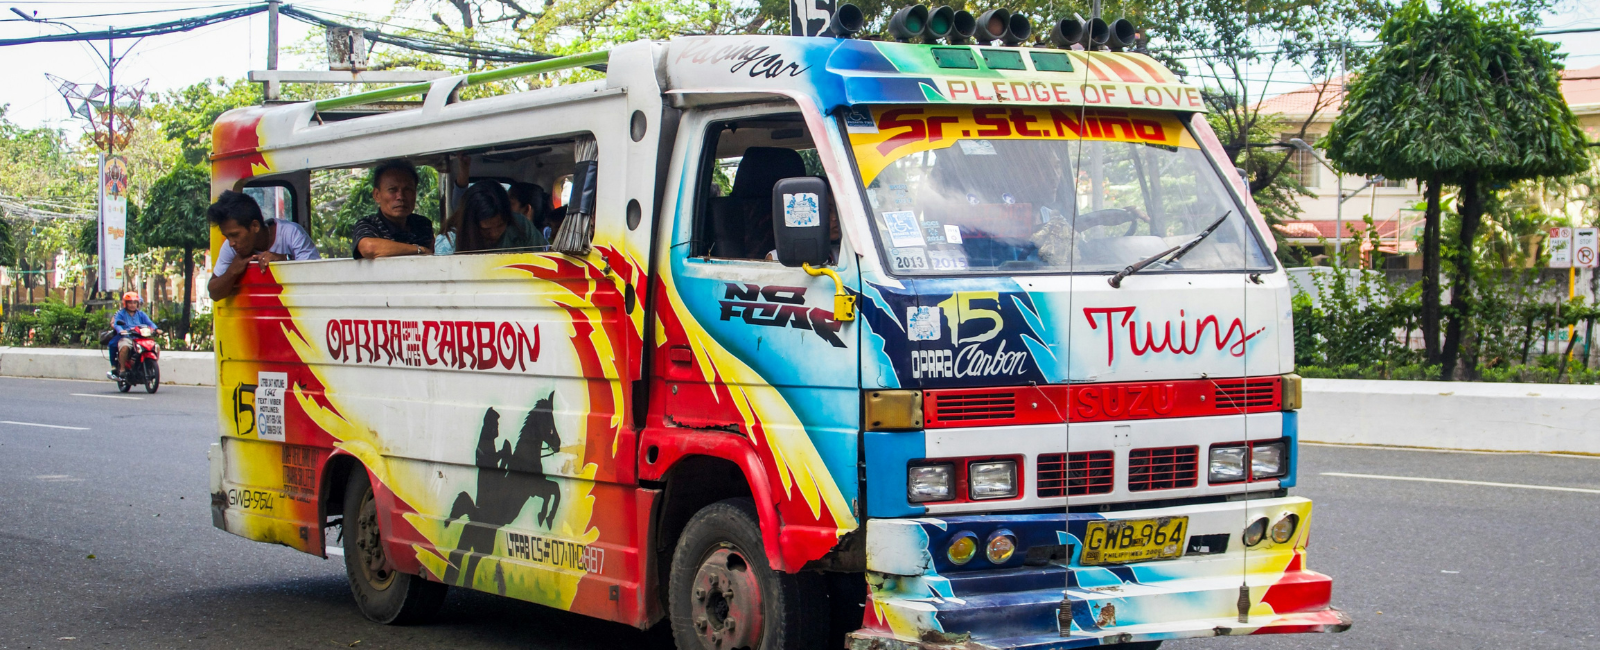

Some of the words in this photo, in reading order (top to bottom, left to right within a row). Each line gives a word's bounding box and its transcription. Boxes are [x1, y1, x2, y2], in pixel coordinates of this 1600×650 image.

[791, 0, 832, 37] 15
[675, 37, 769, 73] Racing
[749, 53, 813, 78] Car
[947, 80, 1070, 103] PLEDGE
[1080, 83, 1117, 104] OF
[1125, 86, 1201, 107] LOVE
[896, 256, 924, 268] 2013
[934, 257, 968, 269] 2015
[724, 282, 808, 306] NO
[936, 290, 1004, 348] 15
[1082, 305, 1265, 367] Twins
[422, 320, 541, 373] CARBON
[953, 339, 1028, 379] Carbon
[232, 381, 256, 436] 15
[257, 397, 267, 405] TEXT
[269, 398, 282, 406] VIBER
[1066, 383, 1174, 419] ISUZU
